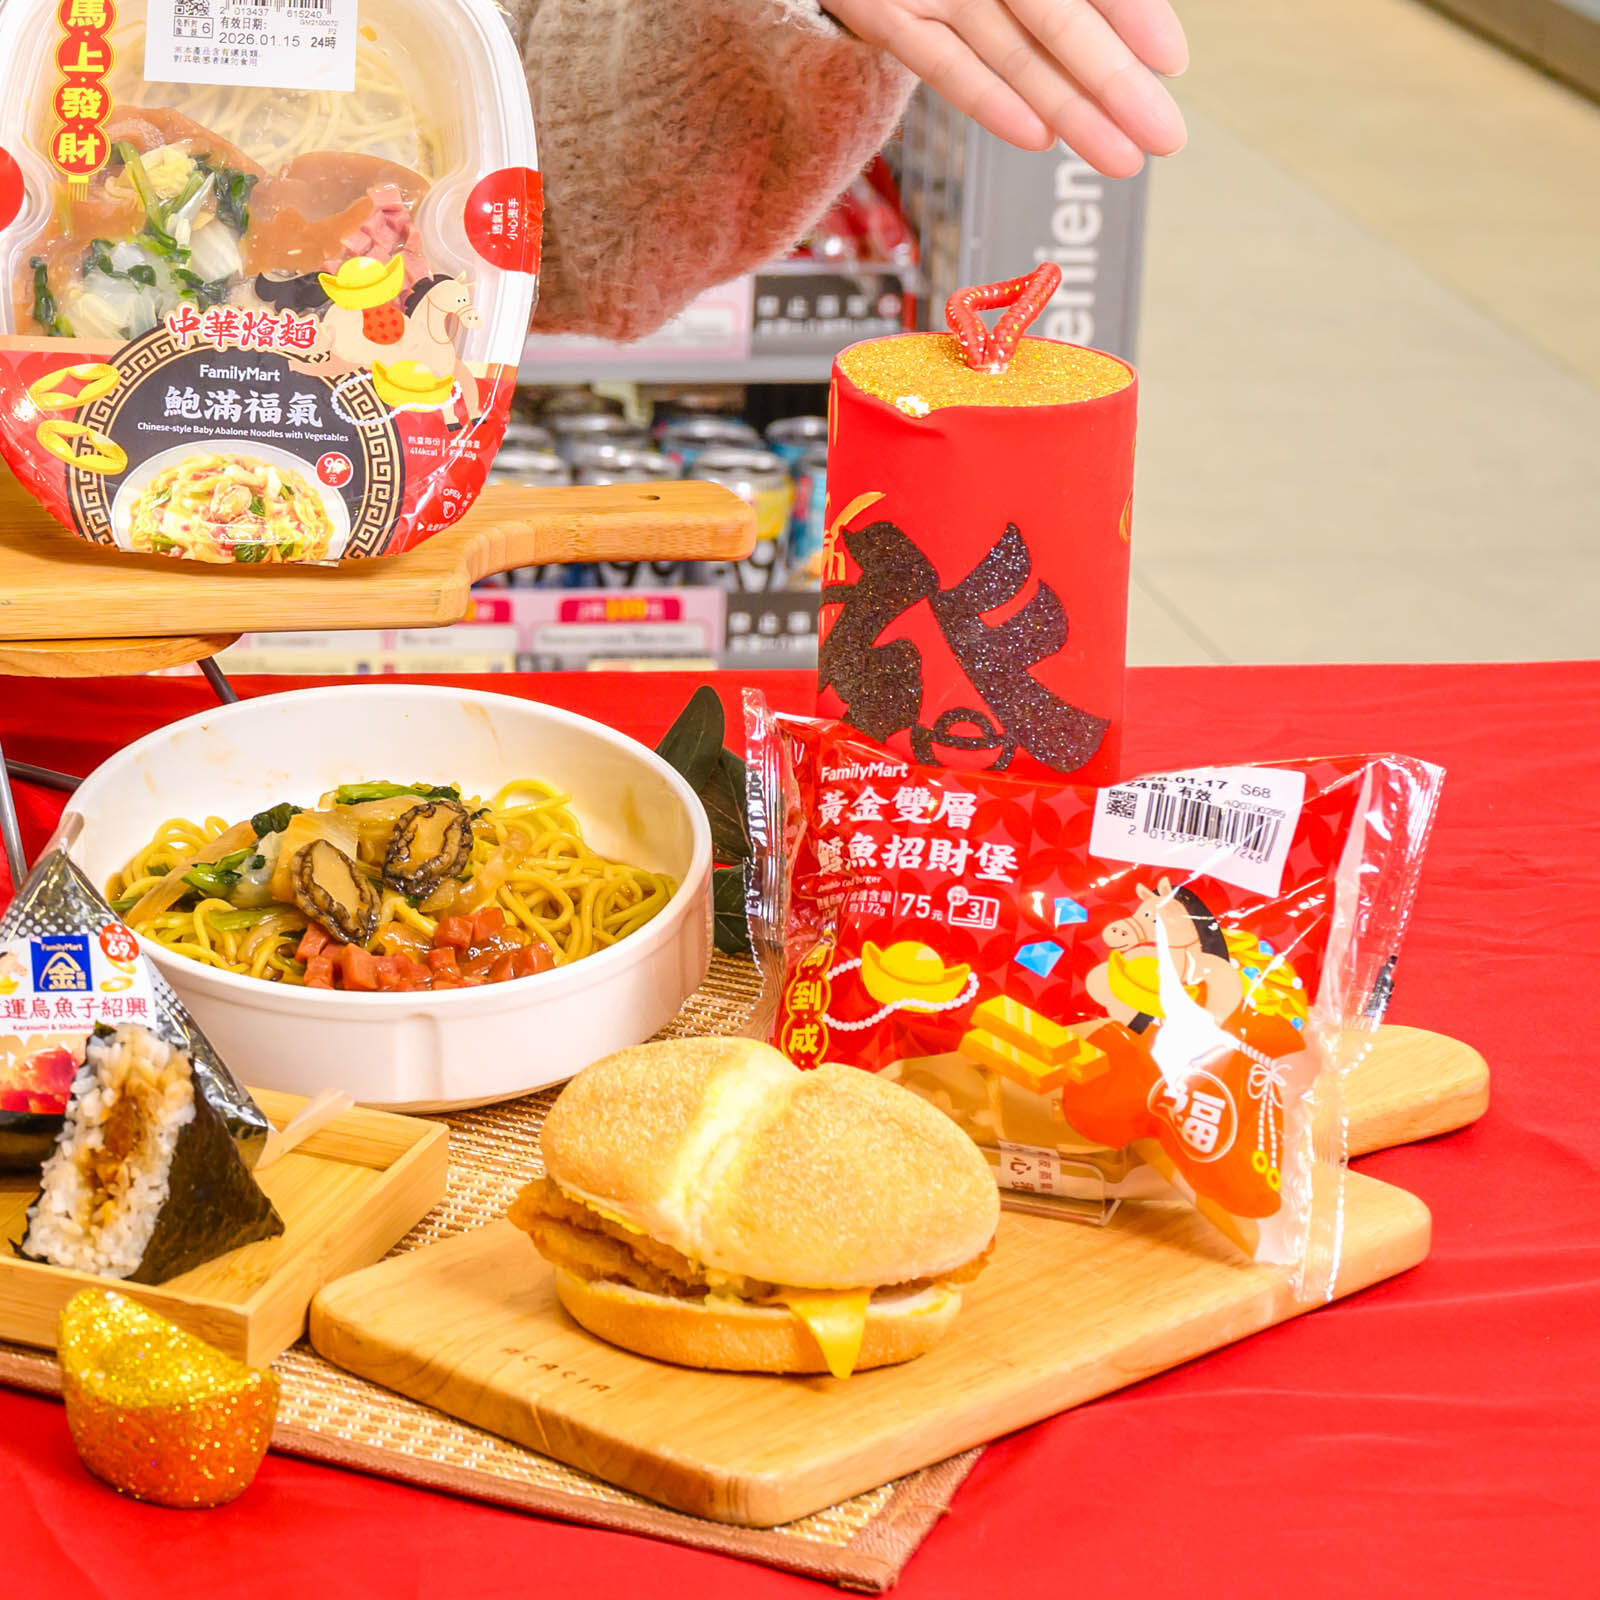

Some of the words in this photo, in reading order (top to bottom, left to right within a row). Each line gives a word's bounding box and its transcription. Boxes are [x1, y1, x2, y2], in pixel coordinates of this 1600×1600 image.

[287, 10, 322, 20] 615240
[202, 22, 211, 35] 6
[218, 31, 301, 48] 2026.01.15
[310, 36, 337, 50] 24時
[168, 305, 318, 350] 中華燴麵
[199, 363, 281, 383] FamilyMart
[162, 384, 323, 429] 鮑滿福氣
[137, 420, 193, 435] Chinese-style
[193, 424, 214, 437] Baby
[215, 425, 249, 437] Abalone
[250, 427, 284, 439] Noodles
[284, 429, 304, 440] with
[304, 430, 349, 443] Vegetables
[820, 761, 909, 783] FamilyMart
[1240, 783, 1272, 799] S68
[817, 785, 978, 831] 黃金雙層
[816, 830, 1019, 885] 鱈魚招財堡
[966, 901, 981, 919] 3
[40, 942, 84, 954] FamilyMart
